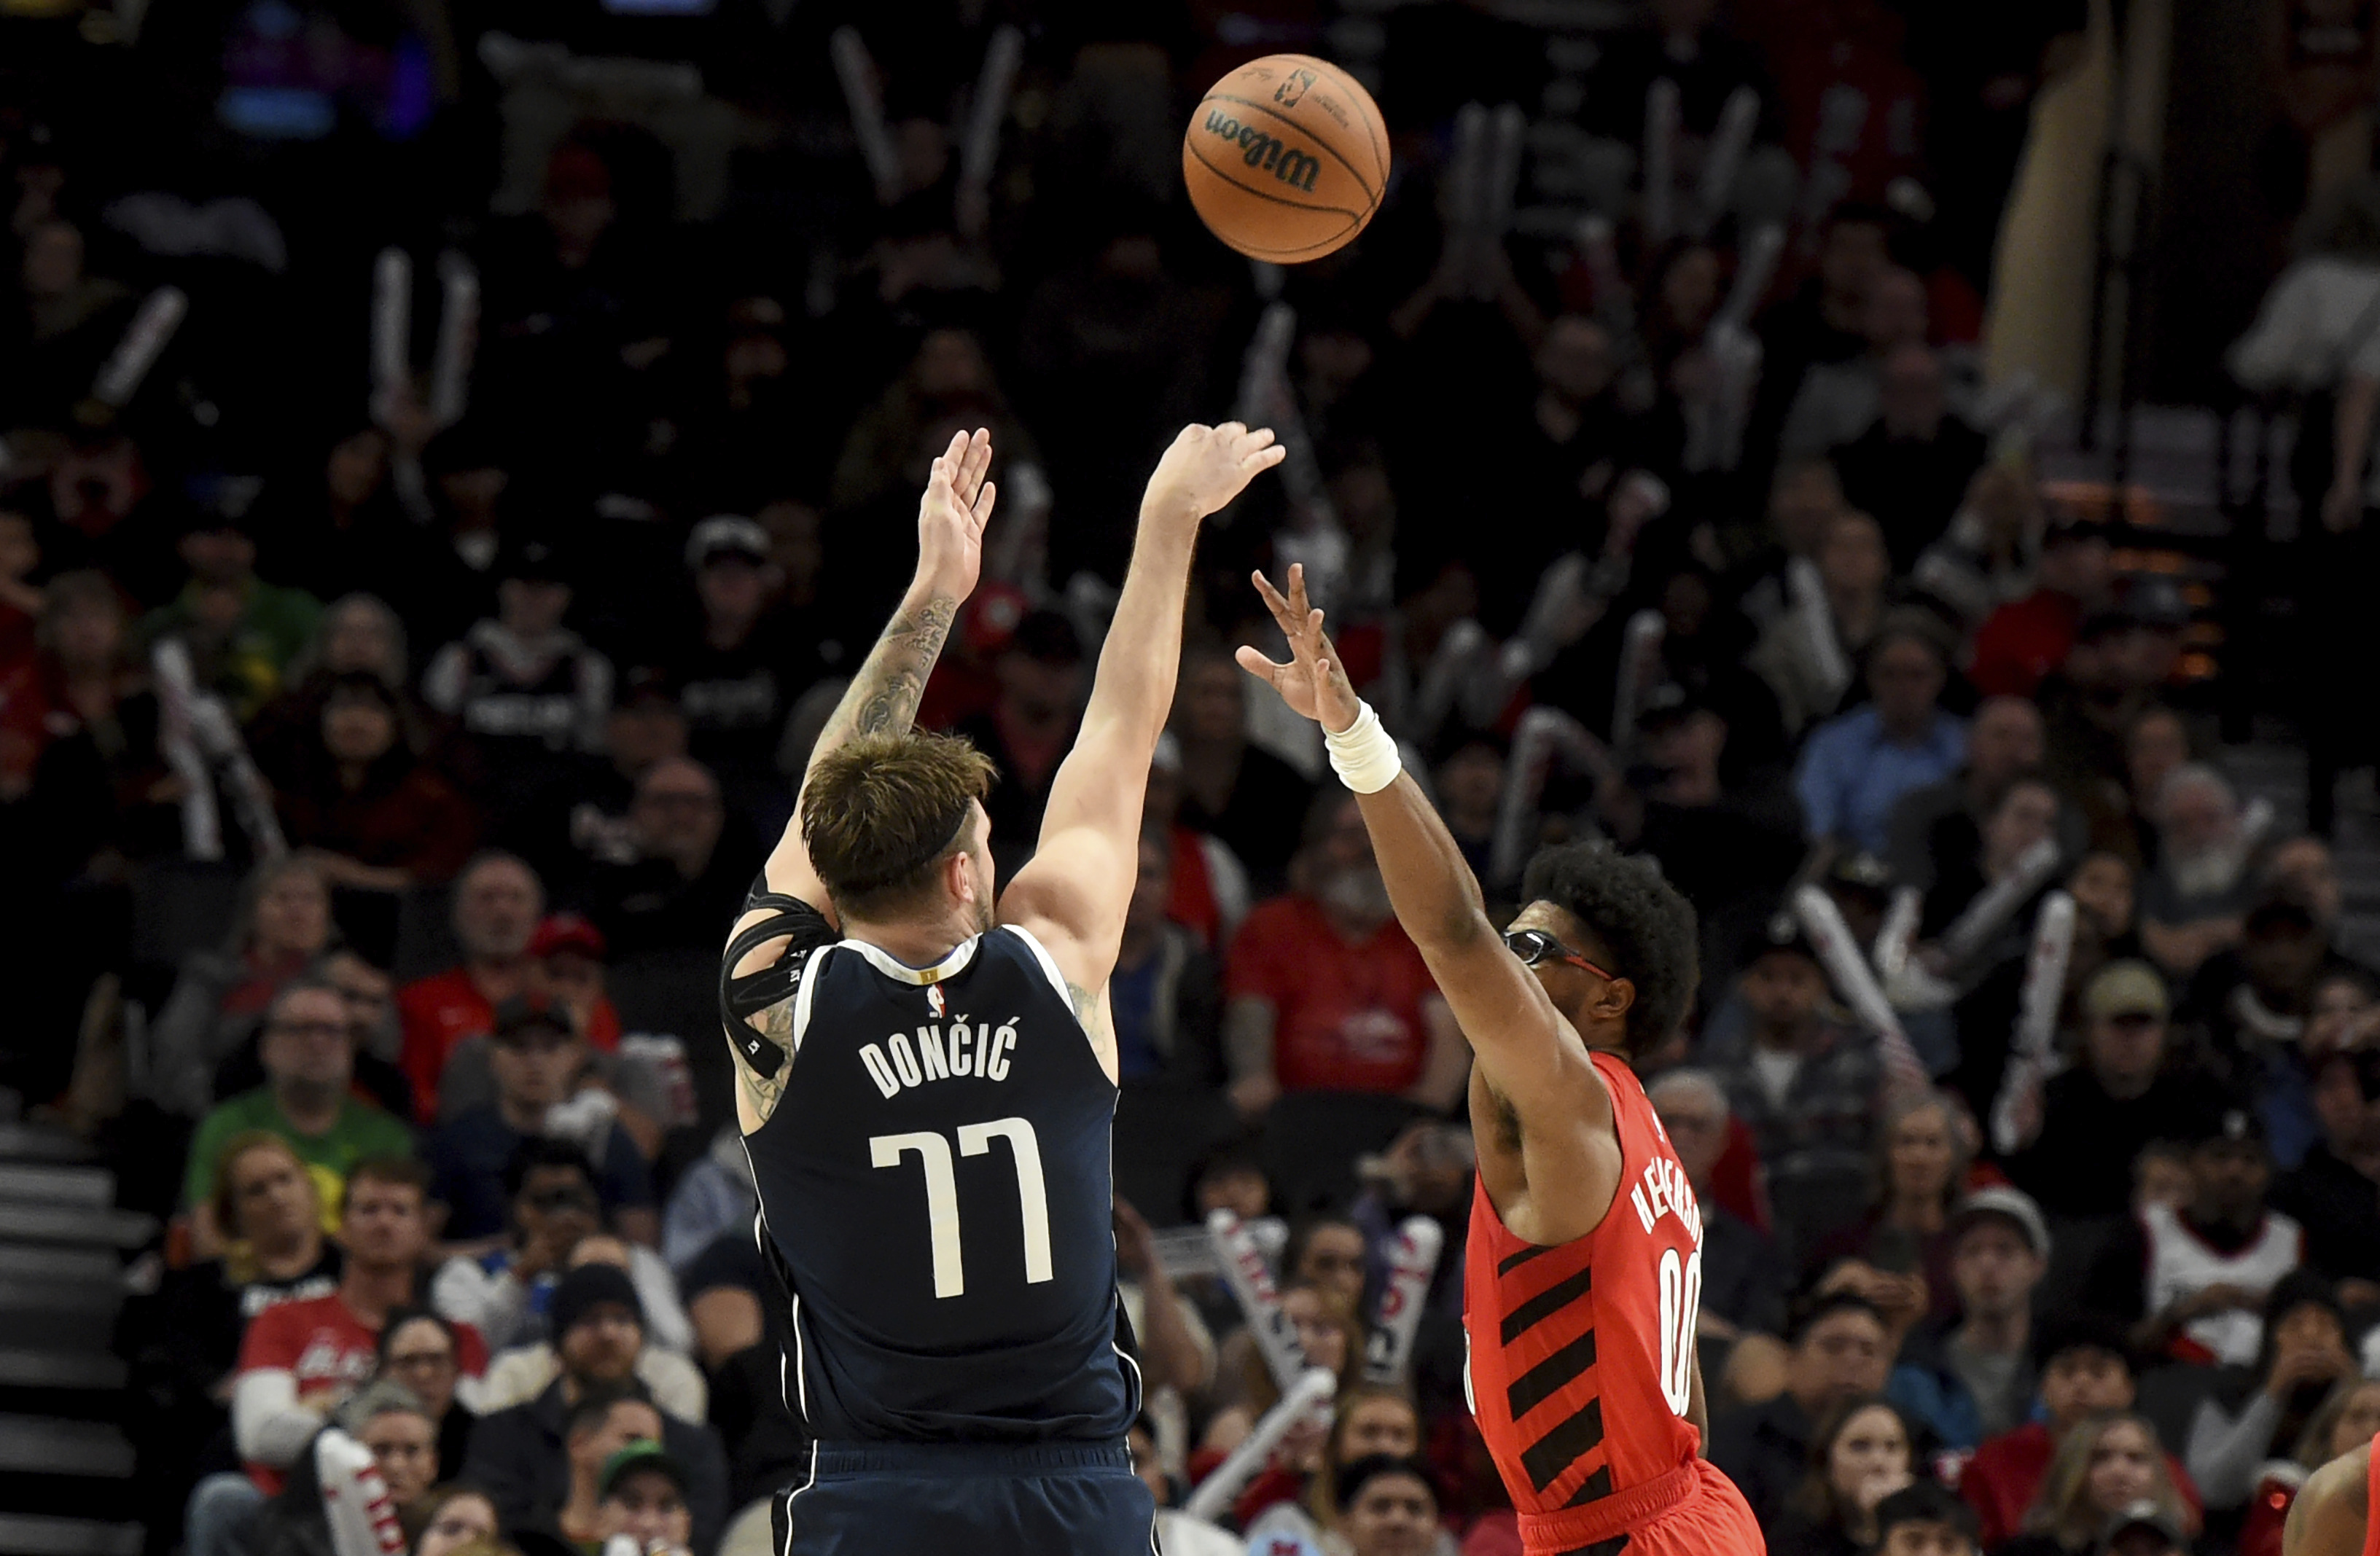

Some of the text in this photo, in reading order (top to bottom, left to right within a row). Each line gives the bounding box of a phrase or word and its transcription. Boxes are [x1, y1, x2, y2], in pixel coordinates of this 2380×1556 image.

[1205, 108, 1321, 194] Wilson
[859, 1014, 1021, 1099] DONČIĆ
[869, 1117, 1053, 1298] 77
[1659, 1248, 1701, 1417] 00
